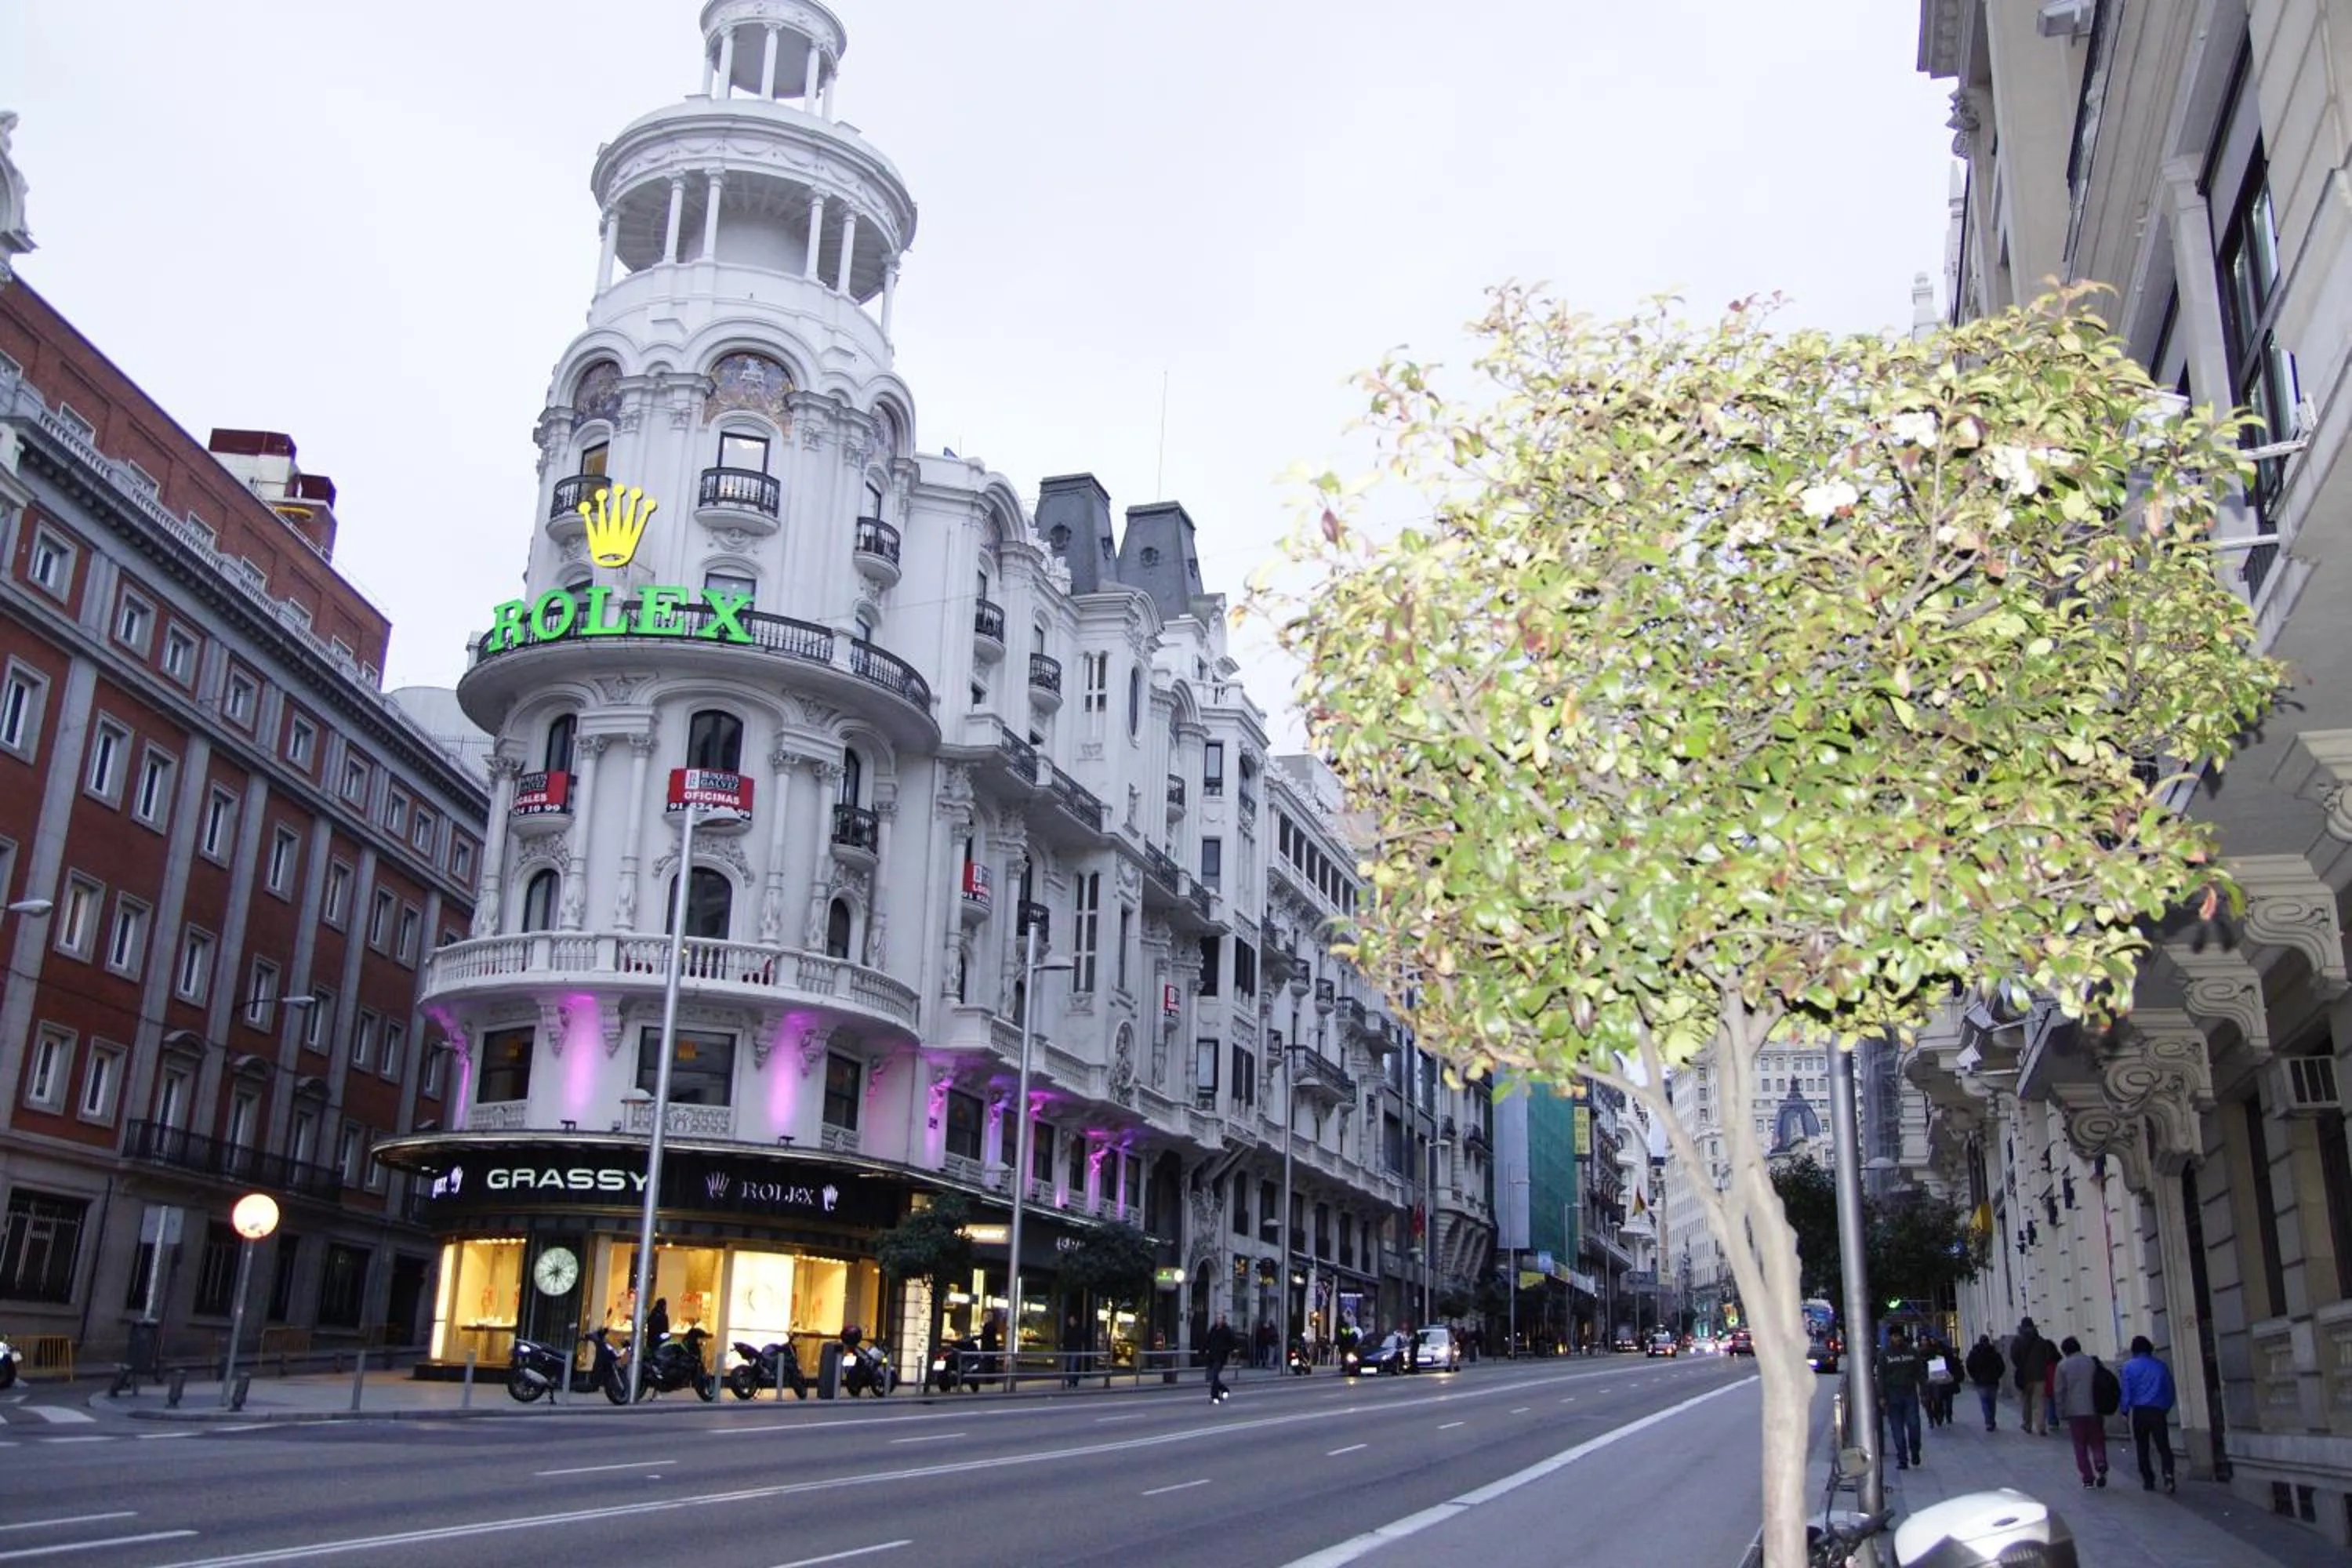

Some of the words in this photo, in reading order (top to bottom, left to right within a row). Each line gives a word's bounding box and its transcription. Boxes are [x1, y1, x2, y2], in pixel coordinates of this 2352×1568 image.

[487, 585, 755, 652] ROLEX
[684, 791, 741, 805] OFICINAS
[487, 1168, 648, 1192] GRASSY
[742, 1181, 815, 1205] ROLEX
